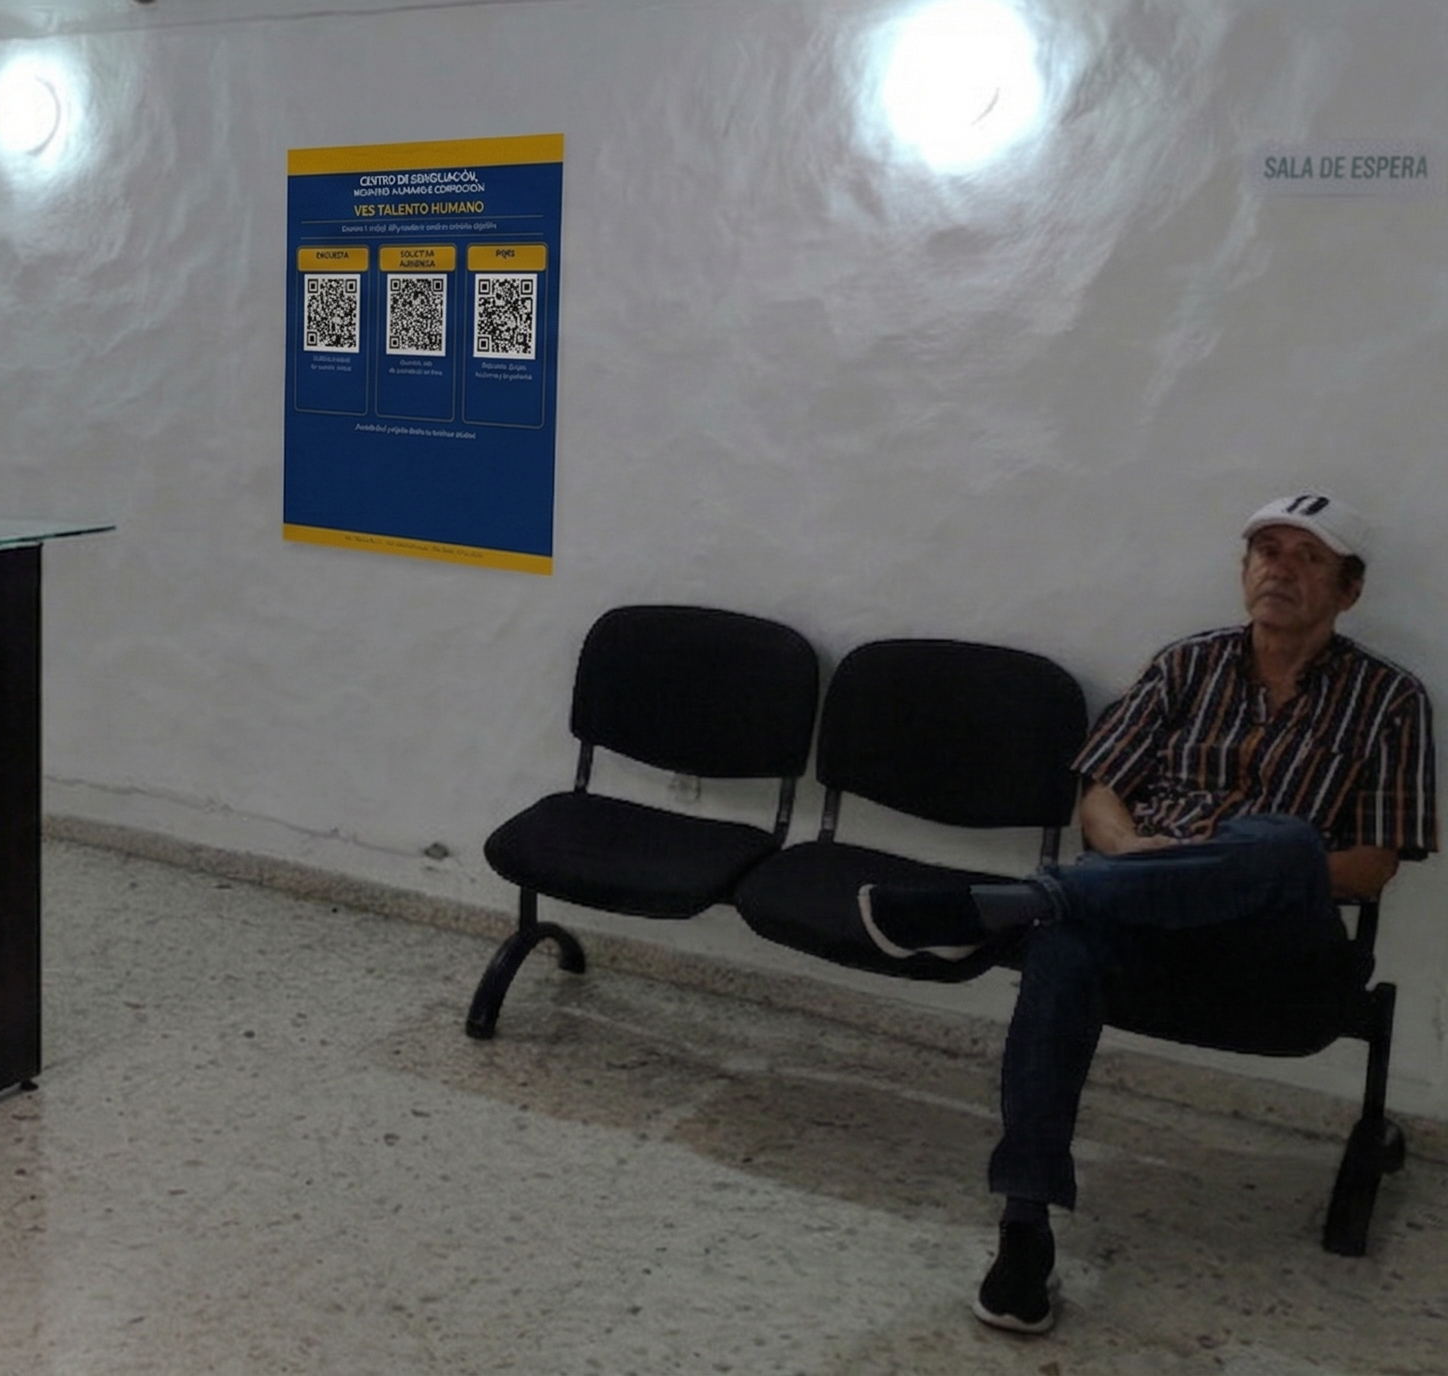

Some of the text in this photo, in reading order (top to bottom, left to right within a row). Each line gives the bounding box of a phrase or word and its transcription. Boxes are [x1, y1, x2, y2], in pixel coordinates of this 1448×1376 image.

[1263, 155, 1429, 179] SALA DE ESPERA
[354, 201, 484, 217] VES TALENTO HUMANO
